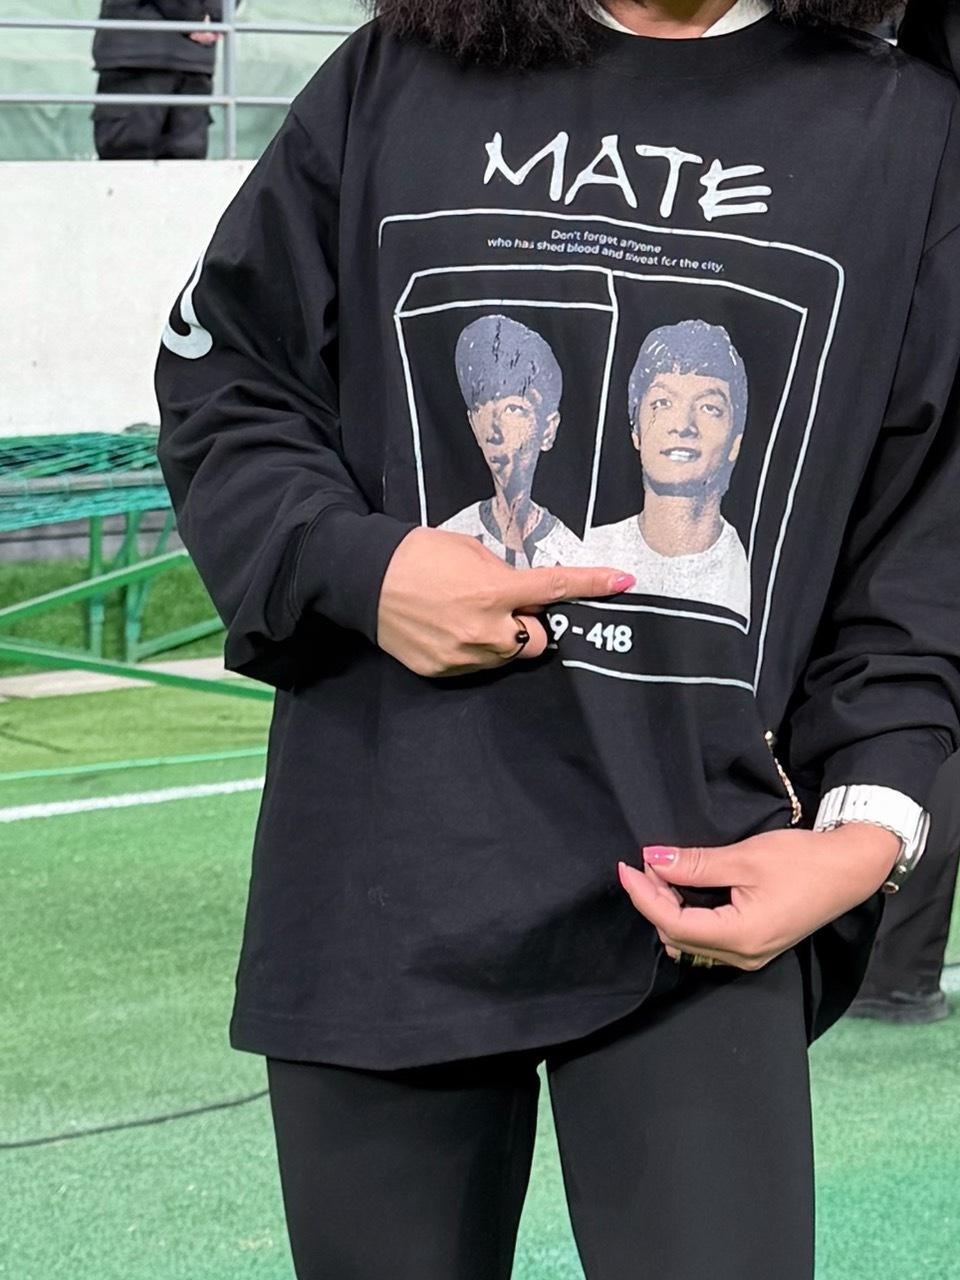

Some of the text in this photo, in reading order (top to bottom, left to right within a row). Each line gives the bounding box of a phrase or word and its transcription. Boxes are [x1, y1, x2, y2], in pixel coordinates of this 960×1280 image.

[483, 131, 772, 221] MATE
[487, 237, 512, 248] who
[514, 238, 535, 249] has
[536, 240, 565, 252] shed
[566, 243, 600, 255] blood
[601, 247, 624, 260] and
[624, 252, 659, 266] sweat
[661, 255, 677, 267] for
[679, 258, 699, 269] the
[551, 229, 662, 254] Don't forget anyone
[547, 613, 633, 653] 9-418
